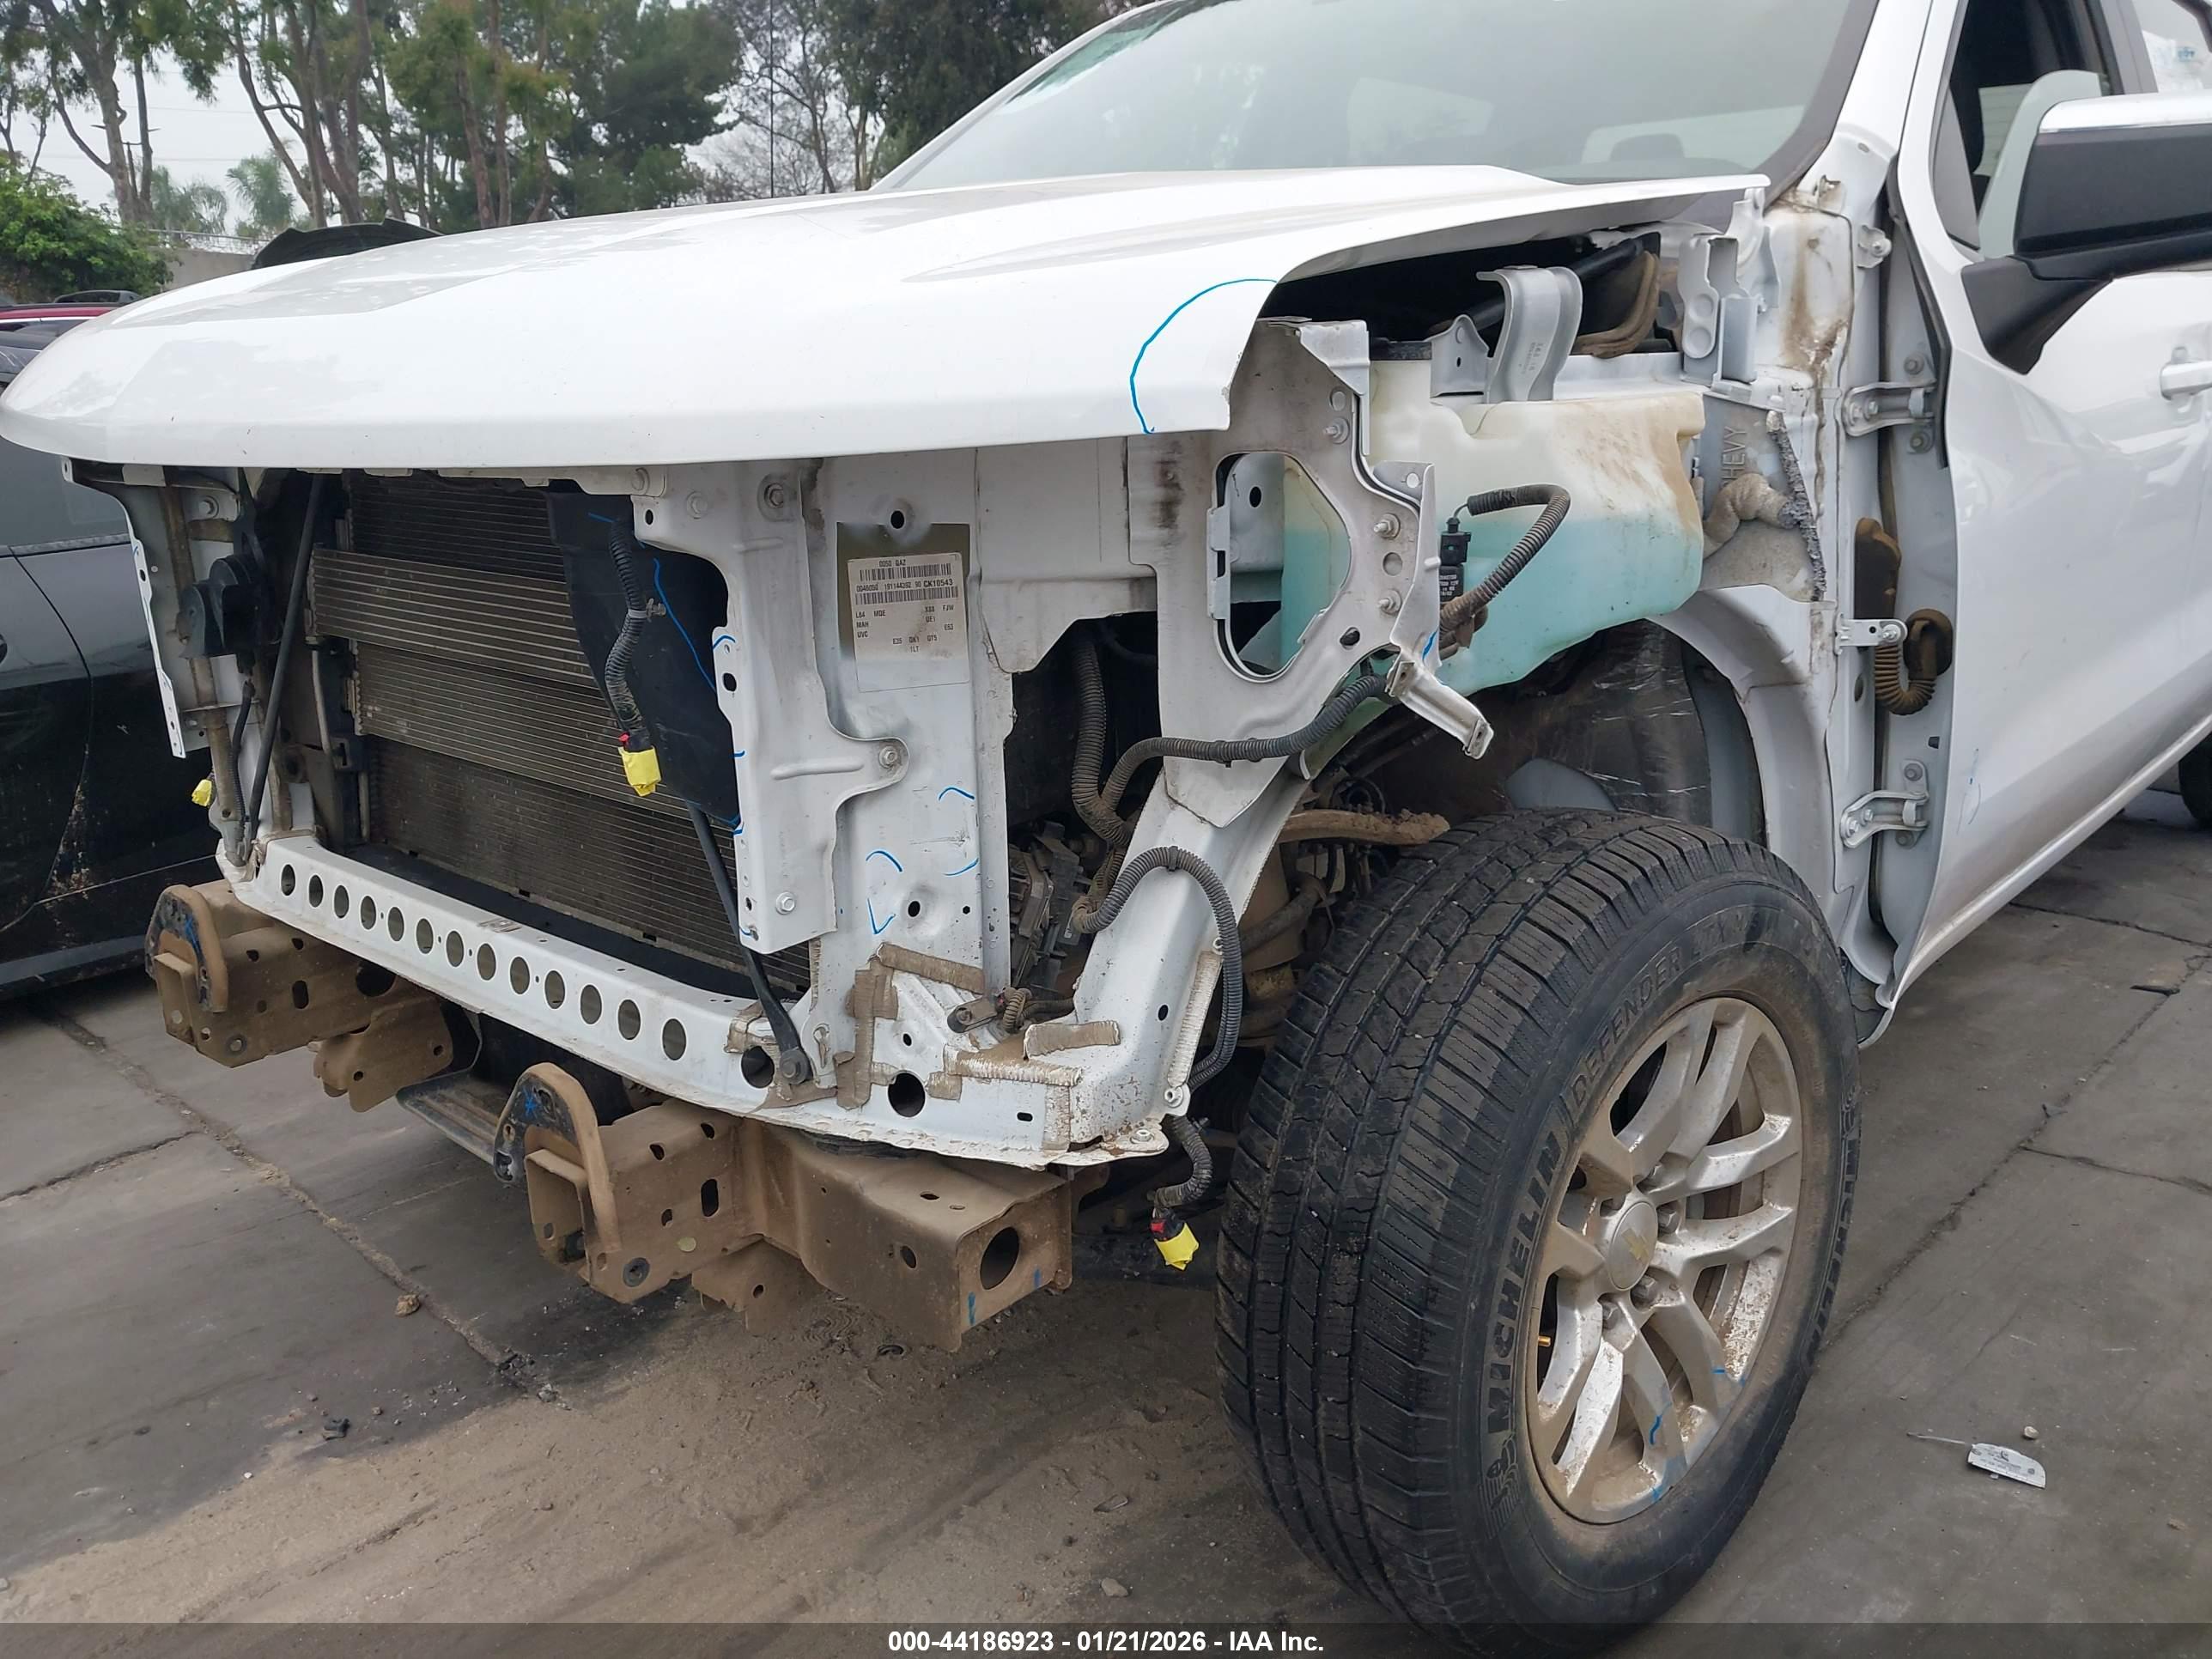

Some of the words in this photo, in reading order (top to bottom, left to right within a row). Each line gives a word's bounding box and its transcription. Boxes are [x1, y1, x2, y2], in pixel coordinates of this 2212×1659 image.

[1721, 426, 1747, 486] HEVY
[923, 578, 953, 587] CK10543
[1487, 1131, 1561, 1433] MICHELIN
[1571, 945, 1683, 1108] DEFENDER
